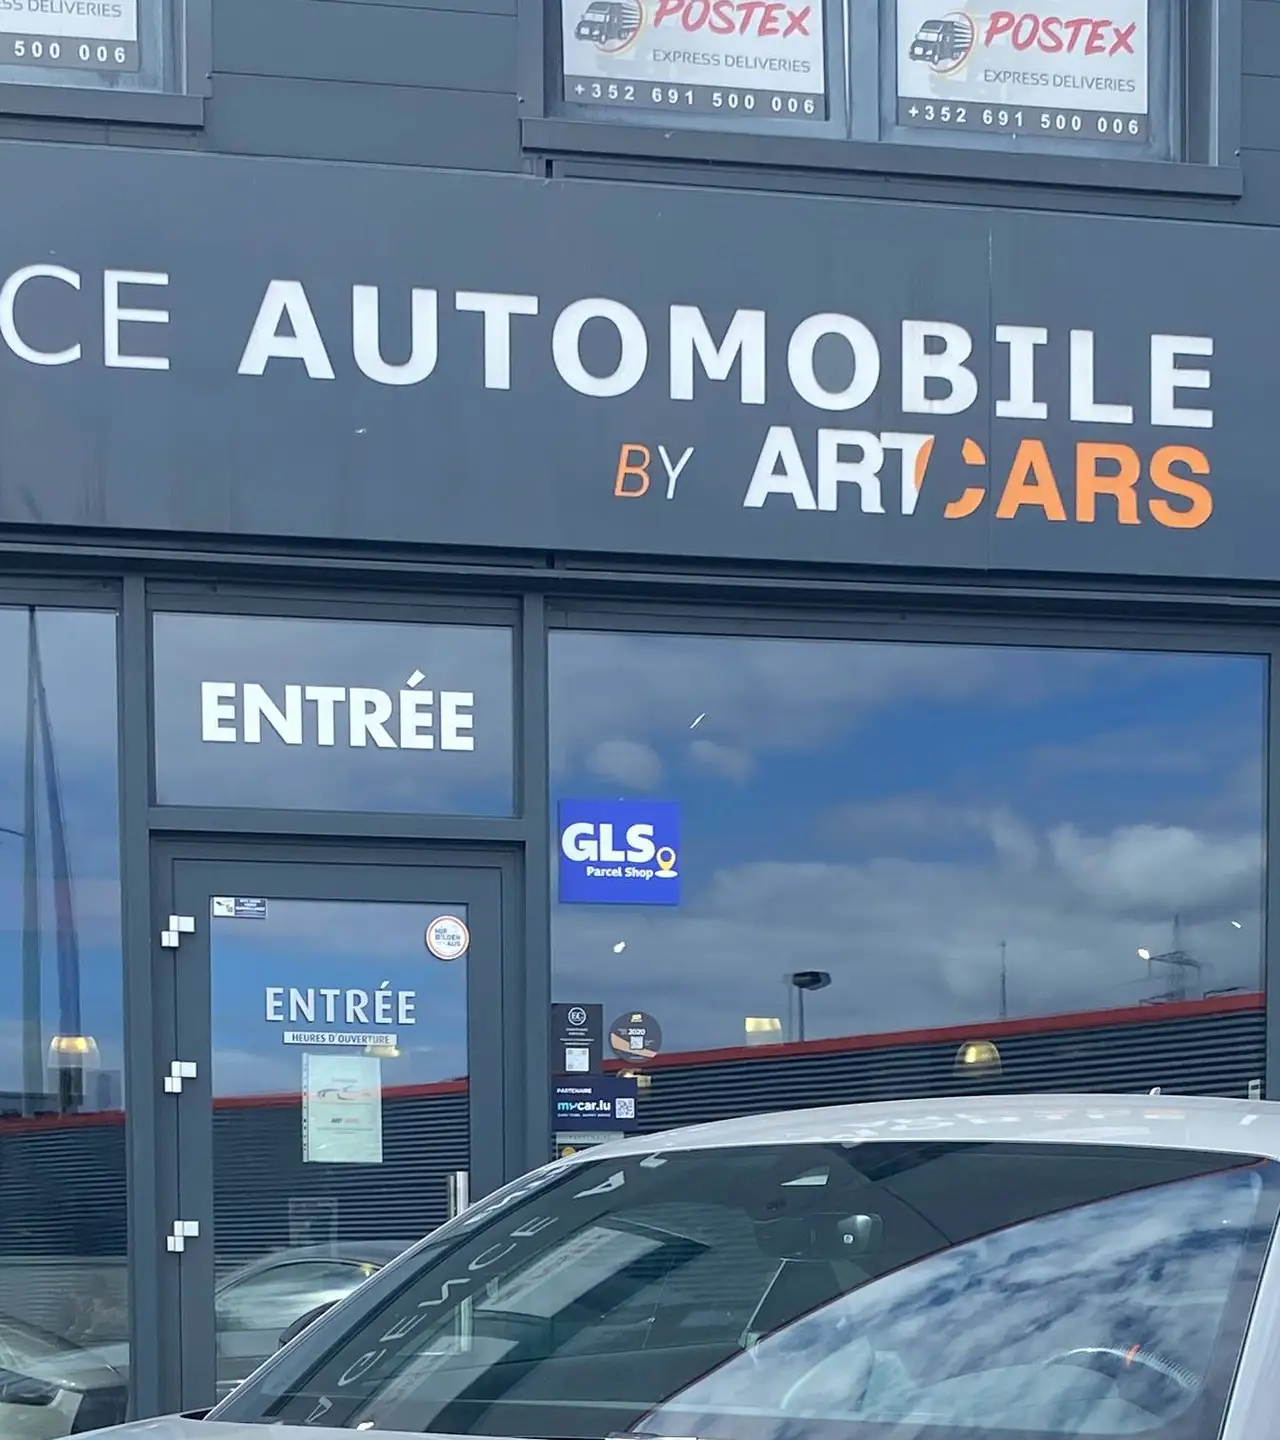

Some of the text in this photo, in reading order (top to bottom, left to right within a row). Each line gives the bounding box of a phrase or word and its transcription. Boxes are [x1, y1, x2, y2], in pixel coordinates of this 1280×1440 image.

[27, 0, 122, 18] DELIVERIES
[984, 10, 1138, 57] POSTEX
[13, 40, 61, 59] 500
[78, 44, 126, 64] 006
[652, 49, 812, 74] EXPRESS DELIVERIES
[983, 68, 1136, 93] EXPRESS DELIVERIES
[573, 82, 816, 115] +352 691 500 006
[907, 104, 1140, 136] +352 691 500 006
[237, 277, 1215, 429] AUTOMOBILE
[612, 442, 695, 502] BY
[200, 668, 475, 752] ENTRÉE
[561, 821, 657, 864] GLS
[586, 865, 655, 881] Parcel Shop
[265, 980, 417, 1025] ENTRÉE
[292, 1032, 390, 1045] HEURES D'OUVERTURE
